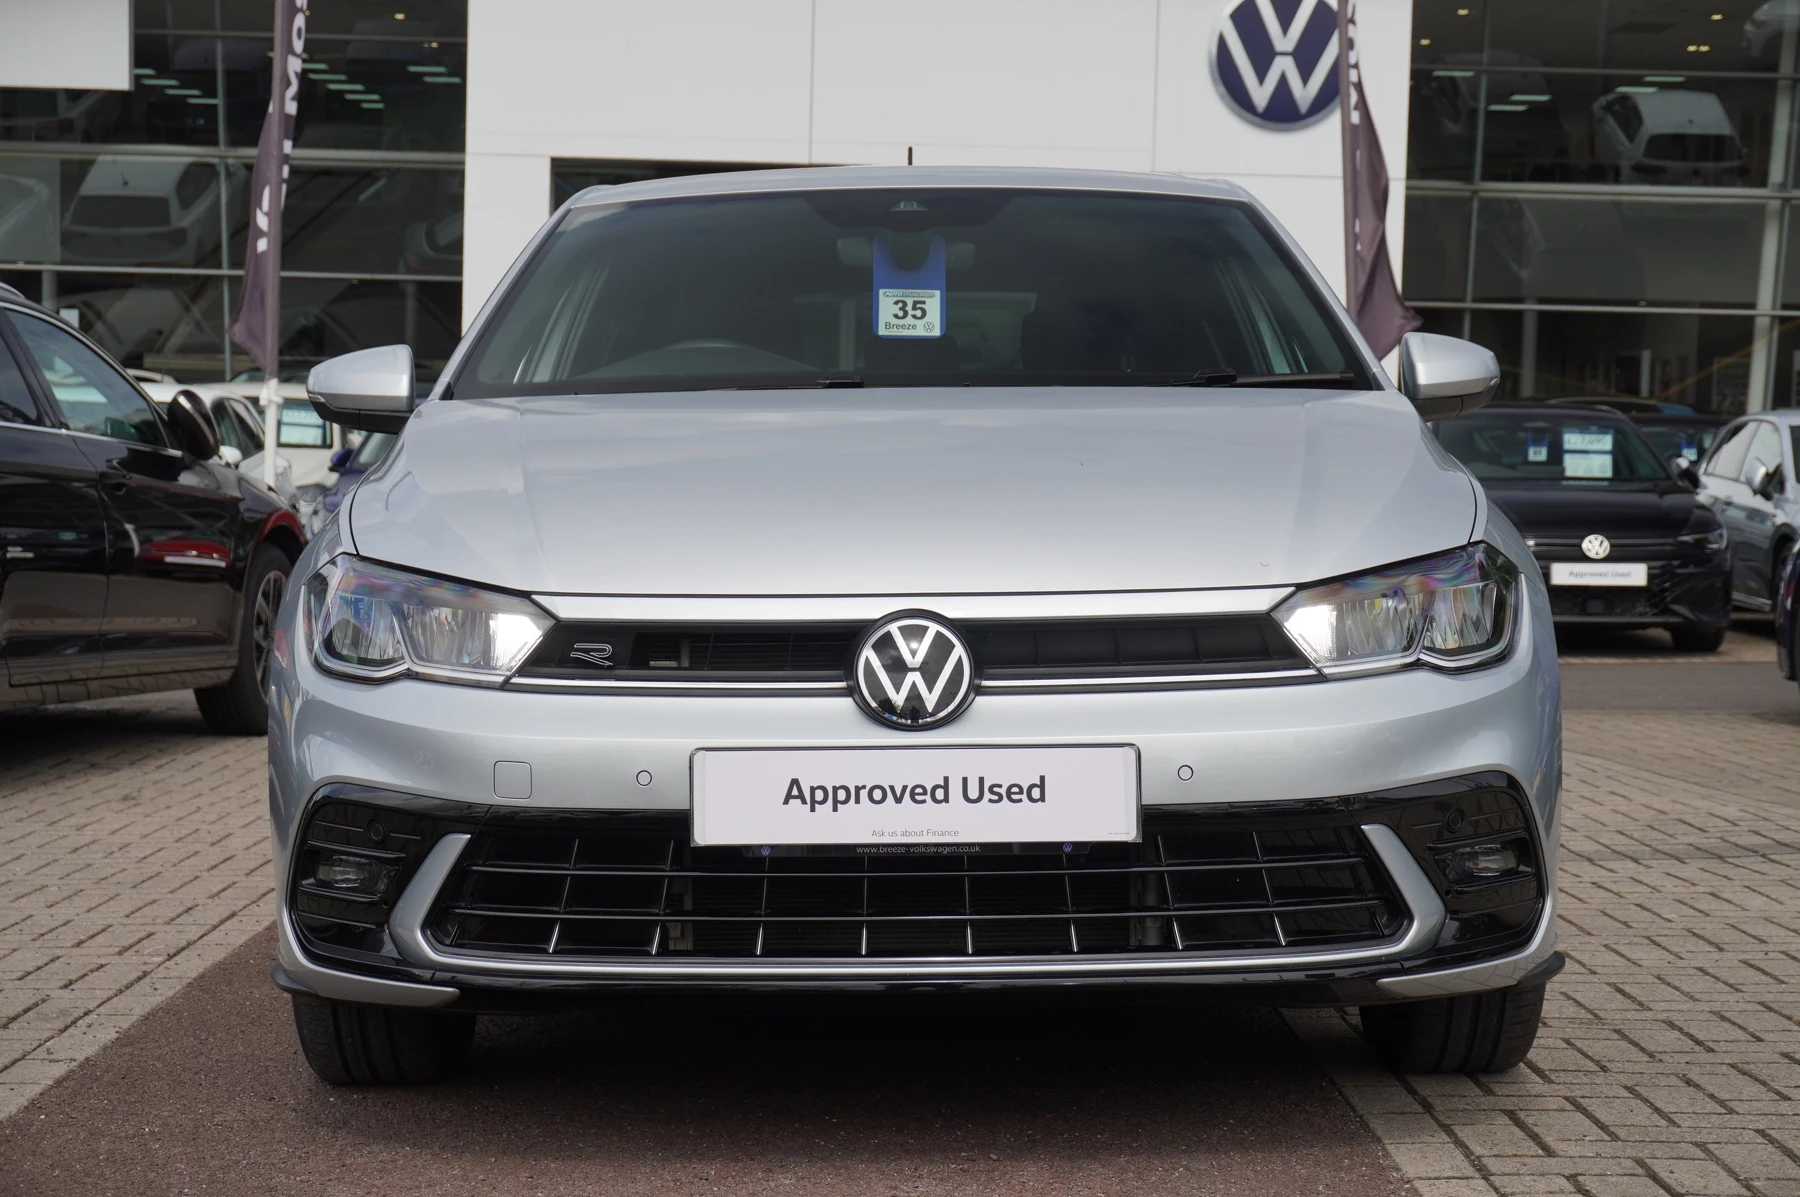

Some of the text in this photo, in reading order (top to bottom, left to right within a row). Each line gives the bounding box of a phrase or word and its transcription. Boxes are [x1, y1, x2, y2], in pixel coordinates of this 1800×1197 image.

[892, 299, 927, 320] 35
[884, 321, 918, 330] Breeze
[1568, 569, 1632, 579] Approved Used
[783, 775, 1046, 813] Approved Used
[871, 829, 886, 838] Ask
[900, 829, 924, 838] about
[926, 828, 960, 837] Finance
[856, 844, 981, 856] www.breeze-volkswagen.co.uk
